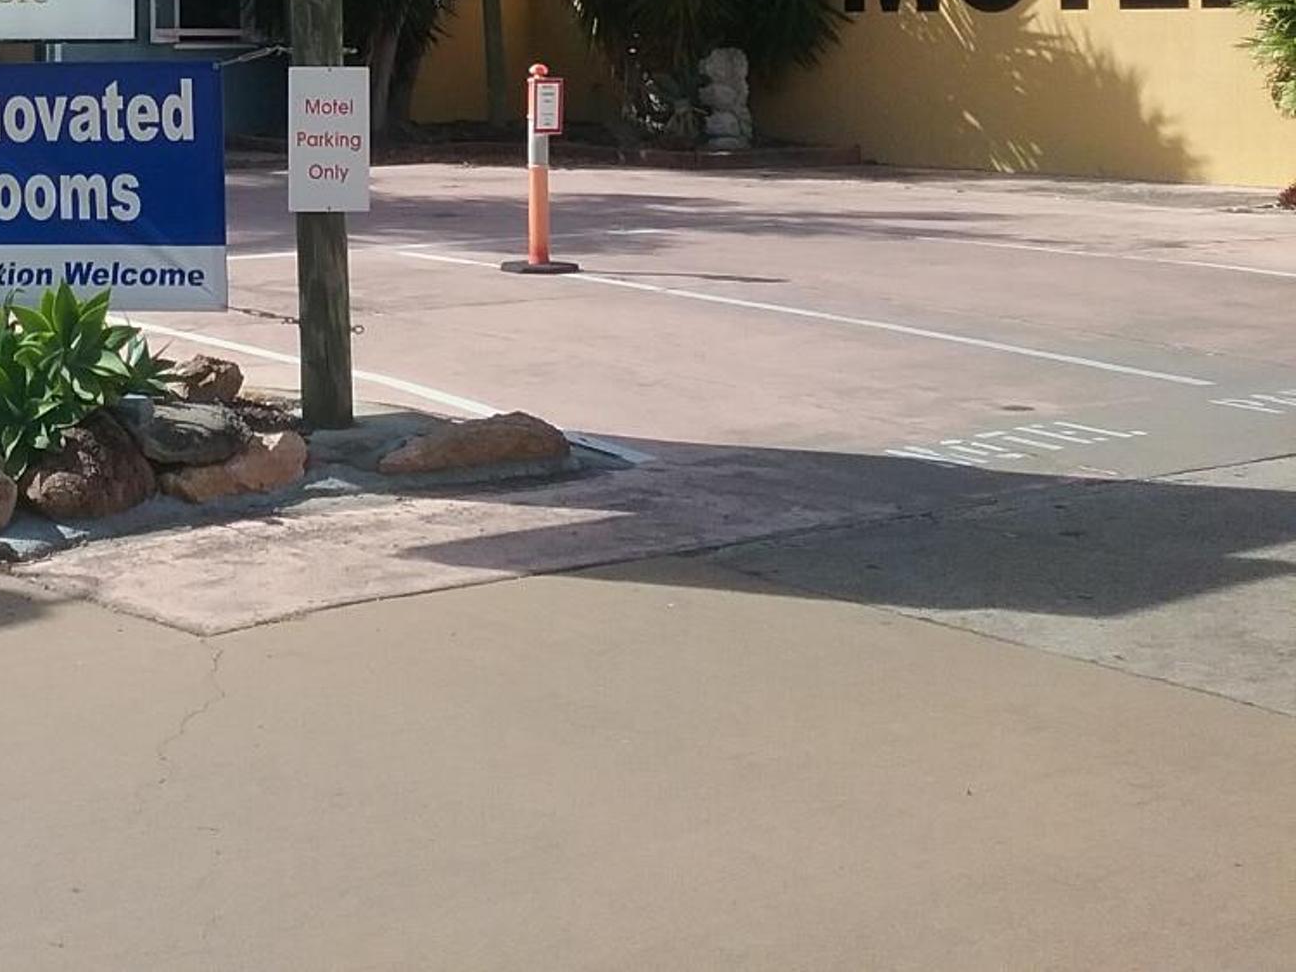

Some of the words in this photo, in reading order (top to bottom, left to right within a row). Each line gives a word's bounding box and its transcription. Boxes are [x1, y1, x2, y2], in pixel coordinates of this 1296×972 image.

[304, 98, 354, 116] Motel
[296, 131, 362, 152] Parking
[307, 164, 349, 183] Only
[64, 261, 206, 287] Welcome
